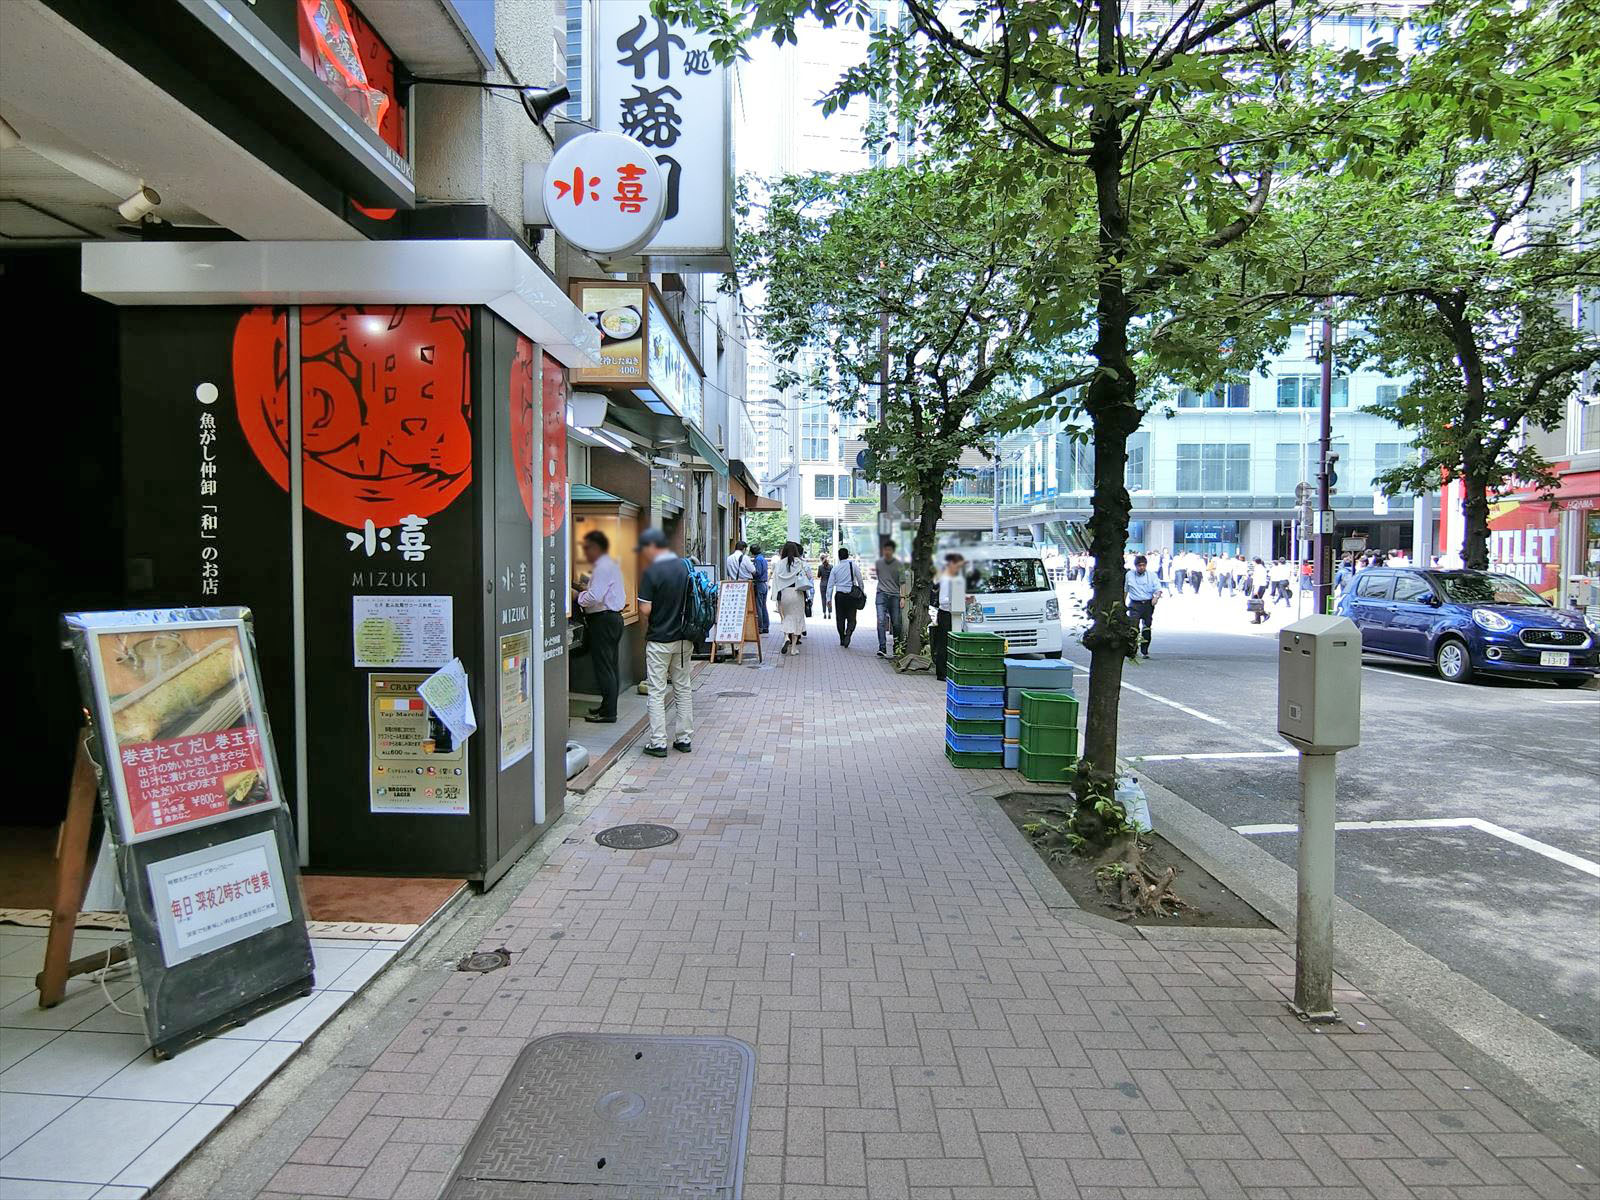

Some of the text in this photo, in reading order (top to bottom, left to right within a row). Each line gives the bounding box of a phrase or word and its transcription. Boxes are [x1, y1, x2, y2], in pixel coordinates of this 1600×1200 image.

[386, 146, 414, 181] MIZUKI
[553, 163, 648, 213] 水喜
[600, 356, 639, 366] 冷したぬき
[345, 514, 431, 561] 水喜
[1485, 528, 1556, 563] UTLET
[352, 572, 426, 587] MIZUKI
[502, 606, 528, 624] MIZUKI
[122, 729, 259, 766] 巻きたて だし巻玉子
[142, 776, 218, 800] いただいております
[171, 869, 272, 920] 毎日 深夜2時まで営業
[307, 924, 397, 935] IZUKI
